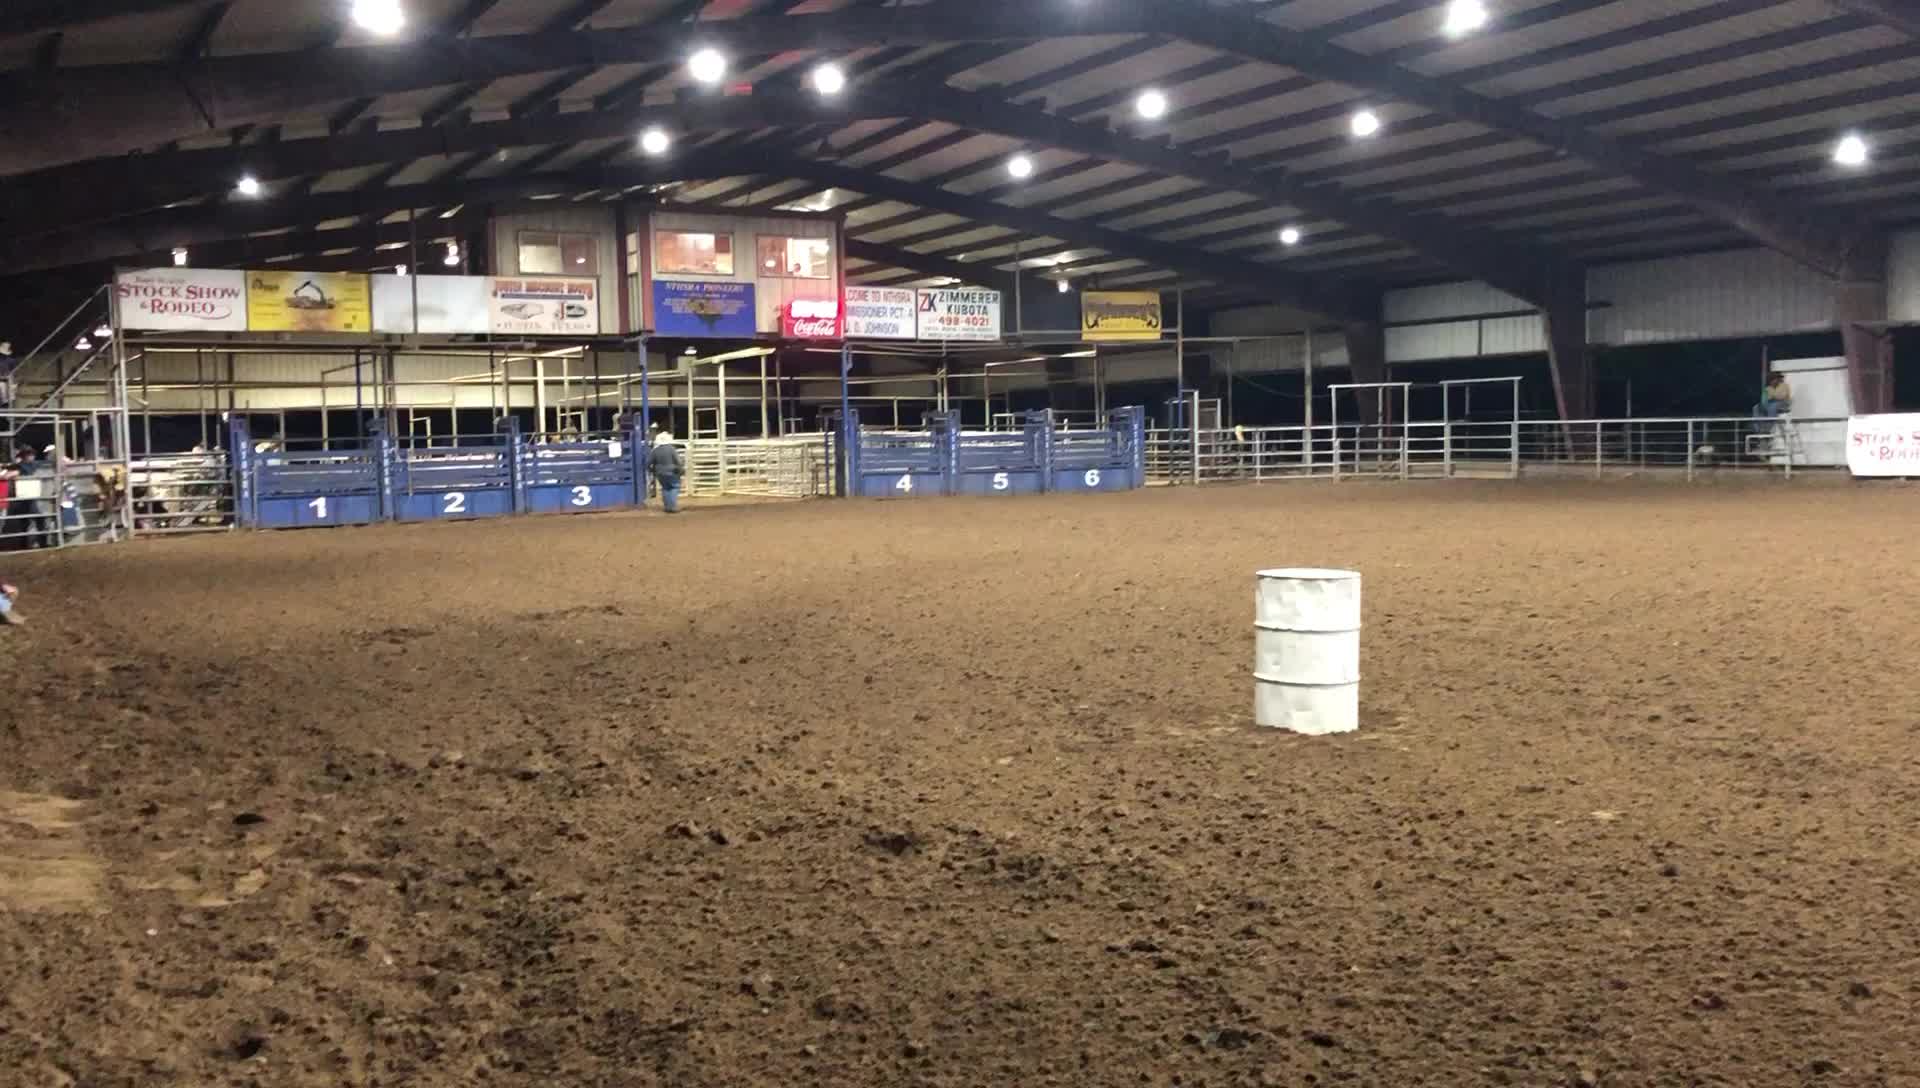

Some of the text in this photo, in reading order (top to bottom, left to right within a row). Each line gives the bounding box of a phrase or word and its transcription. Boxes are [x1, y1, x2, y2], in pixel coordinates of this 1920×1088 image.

[118, 283, 182, 298] STOCK
[185, 284, 240, 300] SHOW
[938, 291, 999, 304] ZIMMERER
[151, 298, 216, 314] RODEO
[947, 304, 989, 316] KUBOTA
[895, 474, 913, 493] 4
[992, 472, 1009, 490] 5
[1084, 469, 1101, 487] 6
[443, 492, 465, 513] 2
[571, 486, 593, 506] 3
[309, 496, 327, 518] 1
